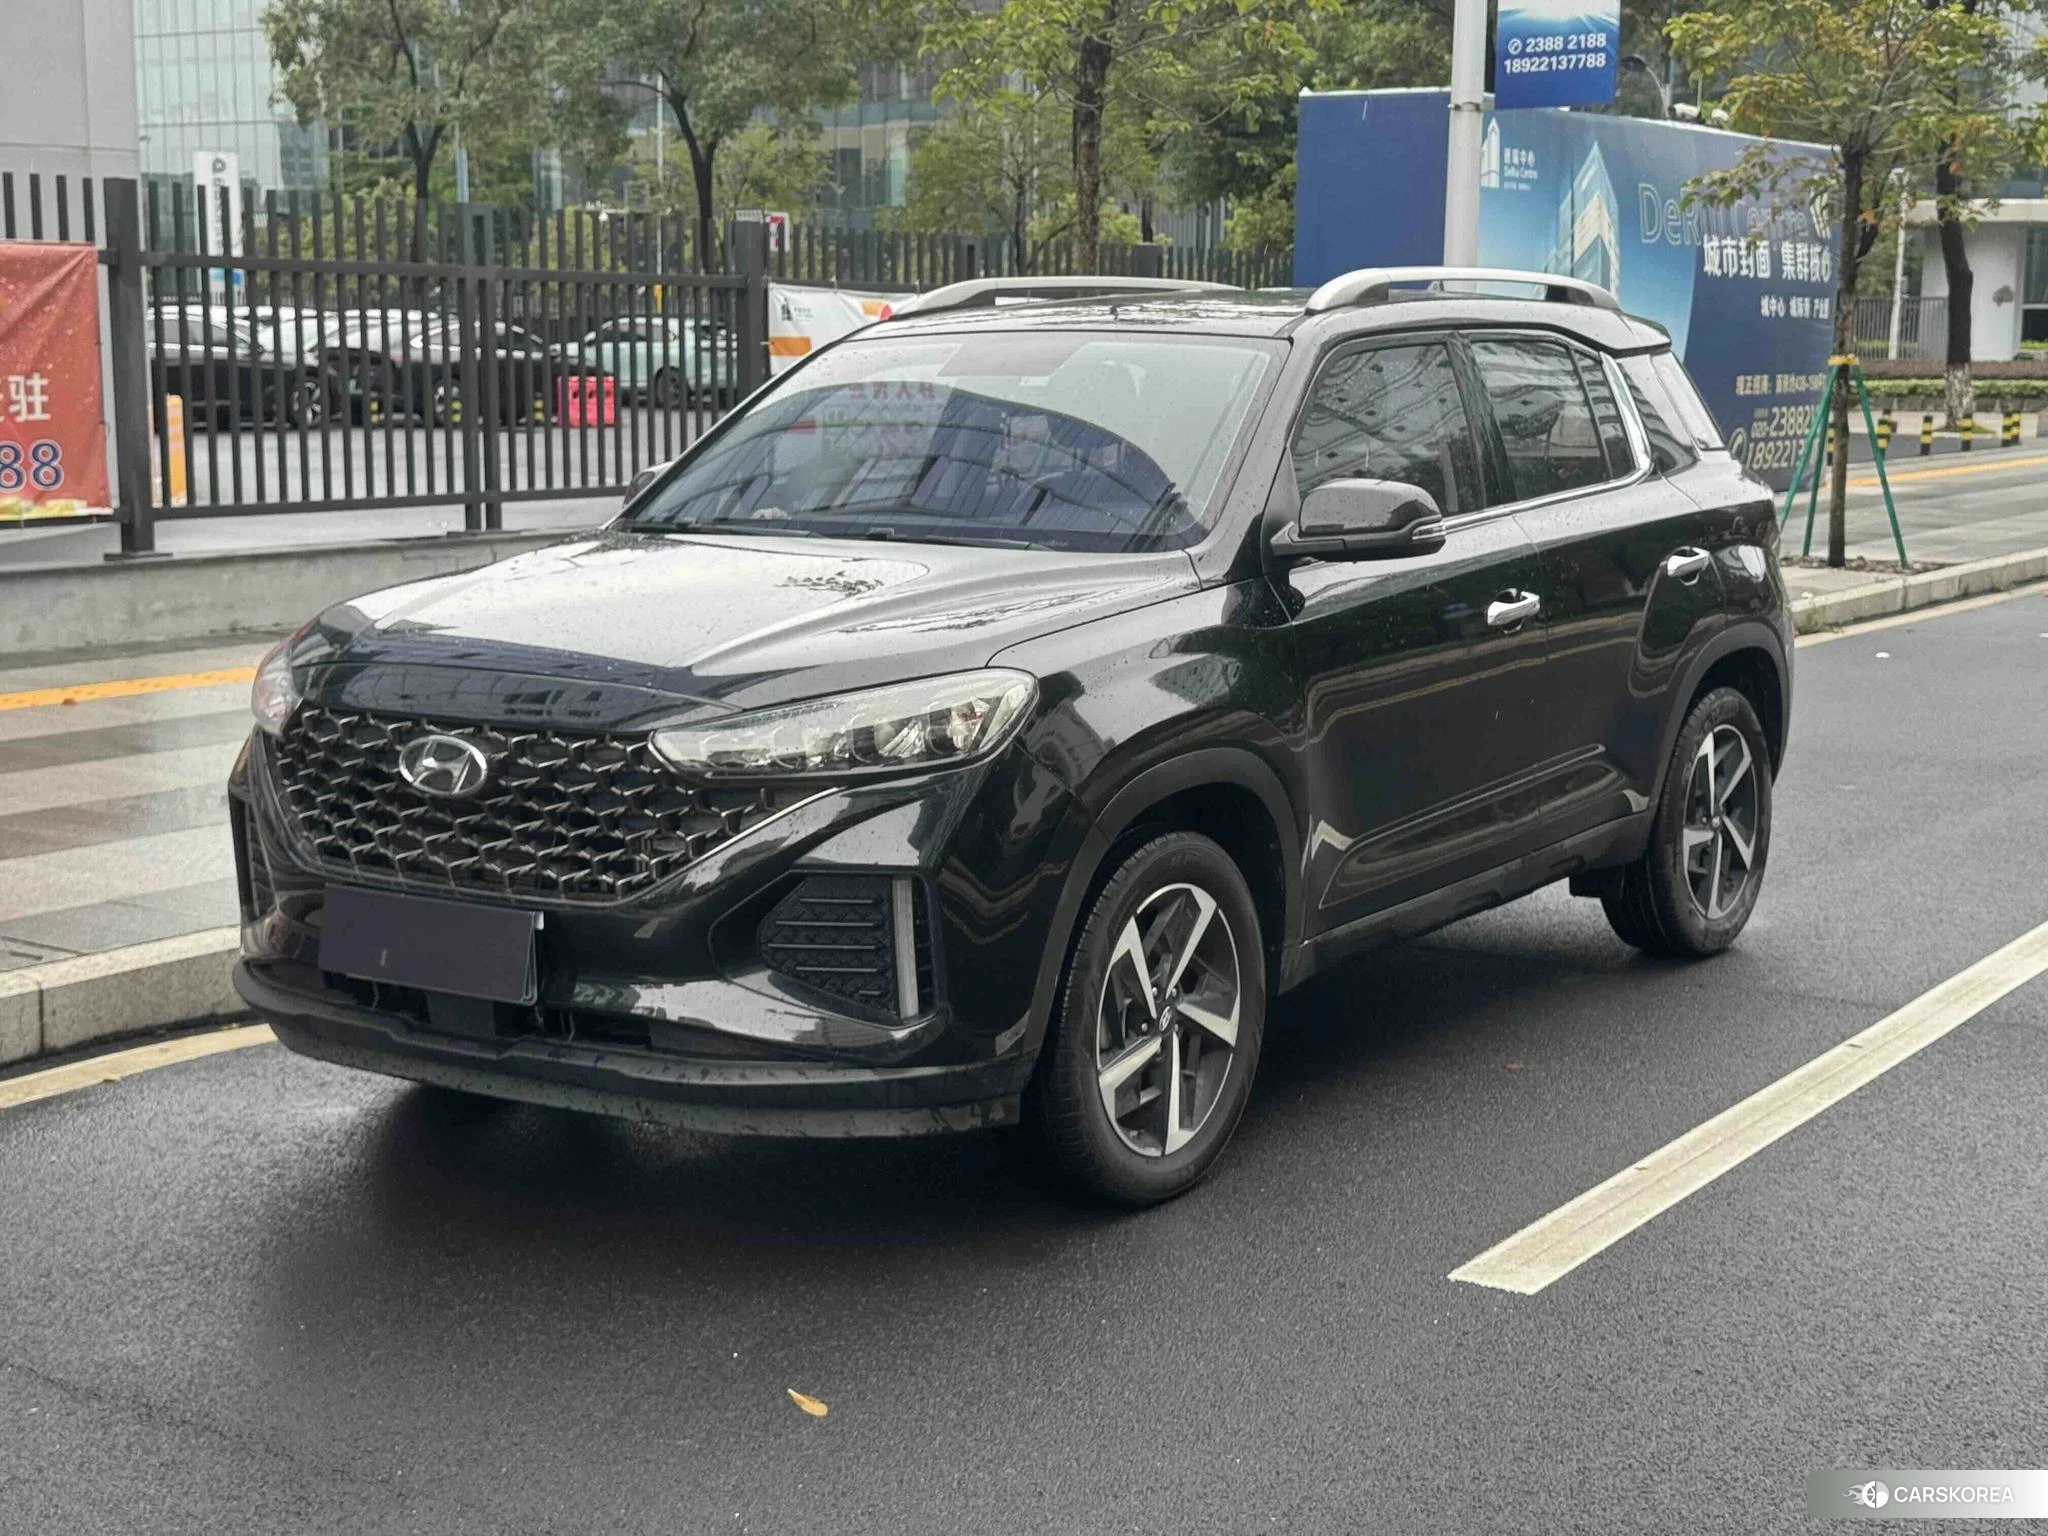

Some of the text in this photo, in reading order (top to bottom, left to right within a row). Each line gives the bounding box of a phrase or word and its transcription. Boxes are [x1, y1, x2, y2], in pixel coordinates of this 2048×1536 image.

[1525, 32, 1607, 53] 2388 2188
[1503, 52, 1607, 74] 18922137788
[1703, 233, 1771, 279] 城市封面
[0, 372, 52, 423] 驻
